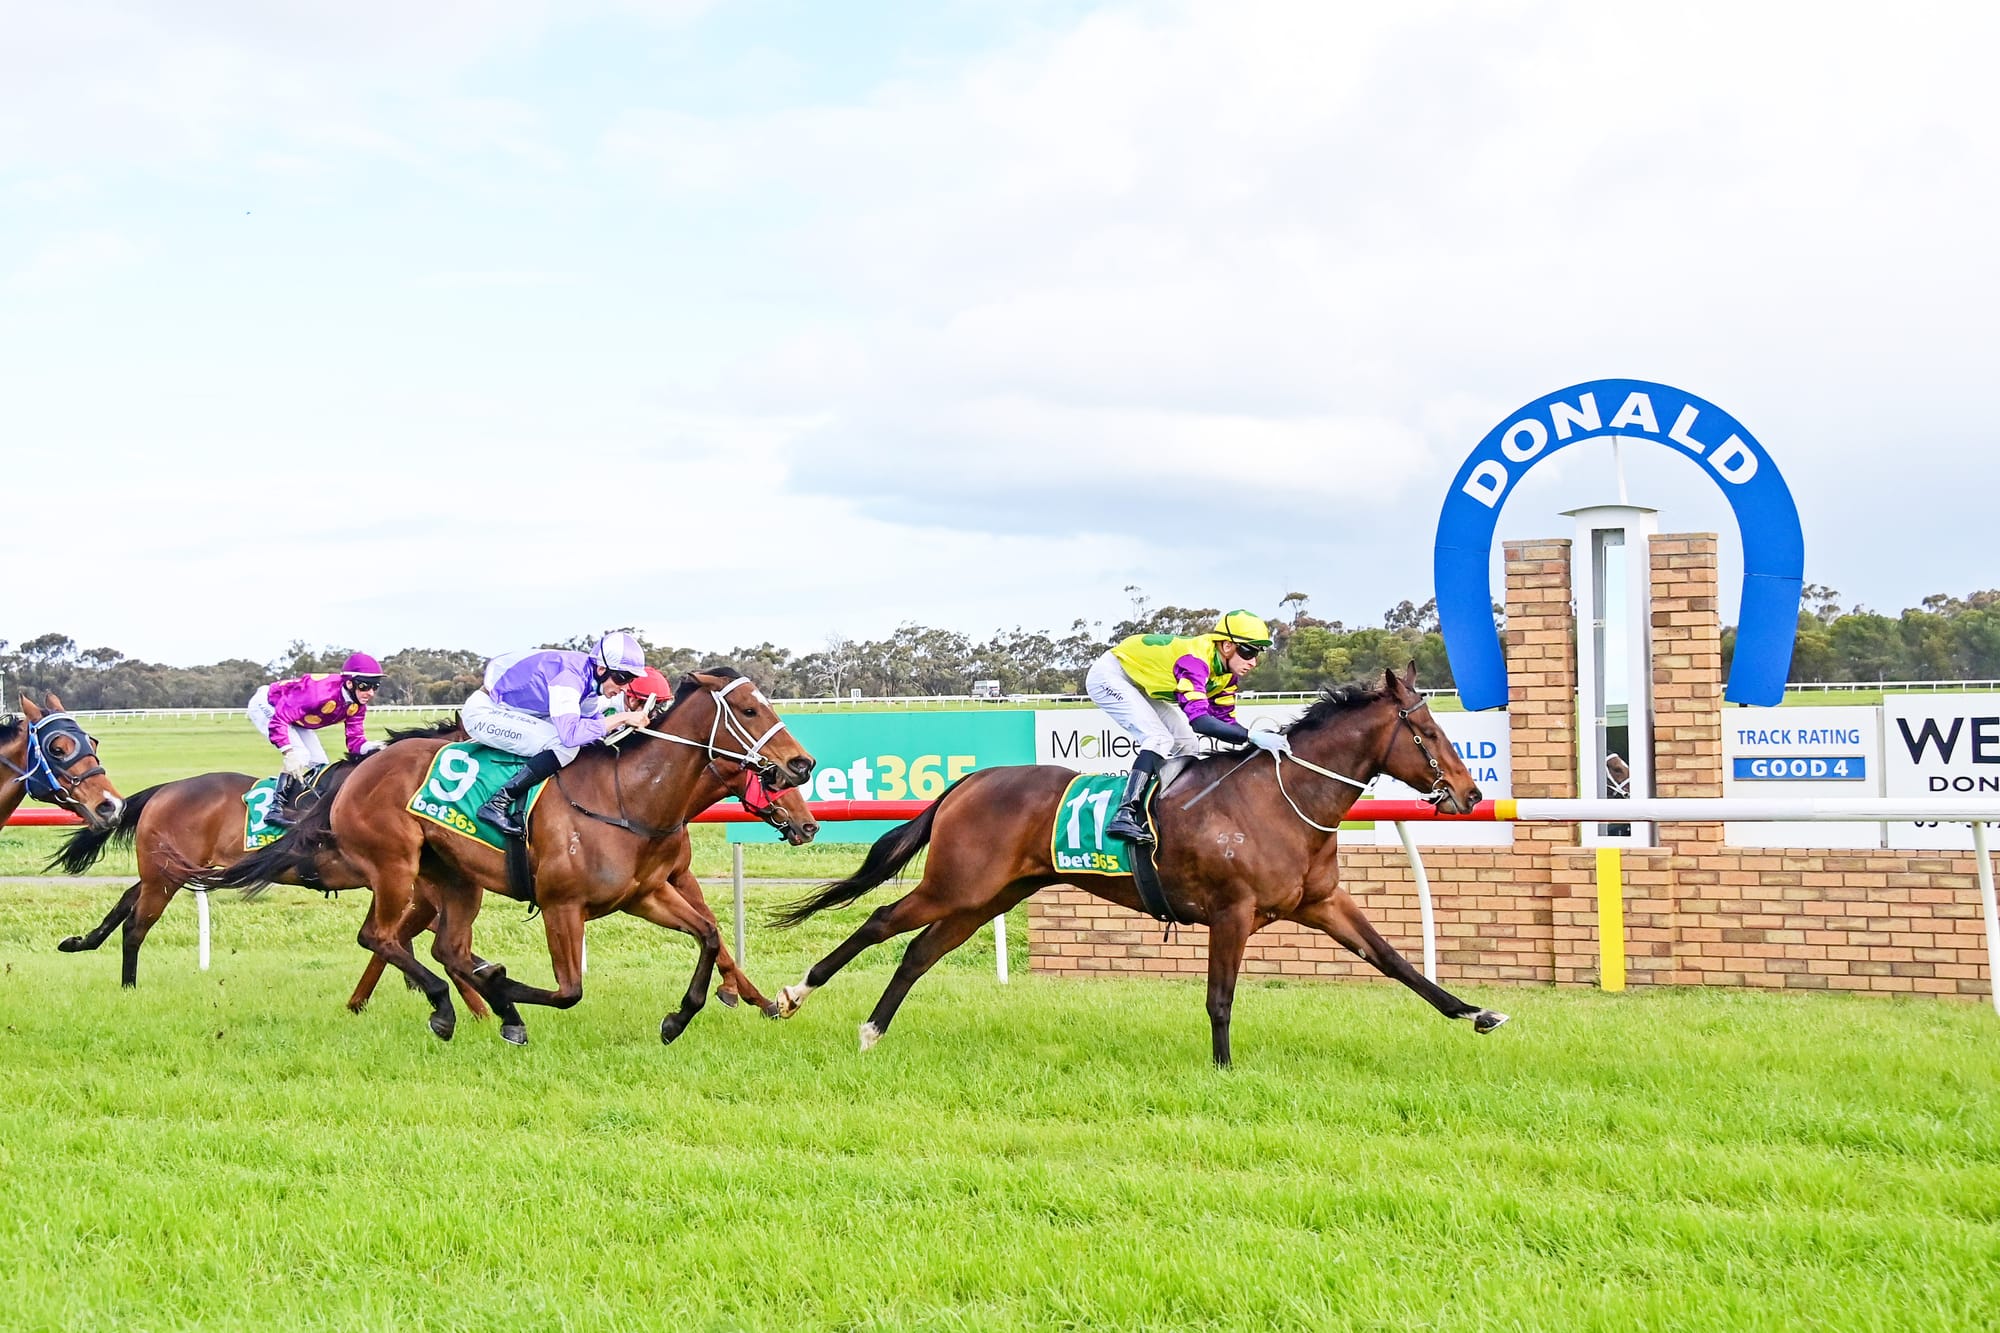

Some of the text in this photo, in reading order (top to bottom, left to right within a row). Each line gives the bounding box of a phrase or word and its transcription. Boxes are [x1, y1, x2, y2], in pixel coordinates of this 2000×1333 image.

[1462, 391, 1759, 509] DONALD
[1737, 729, 1860, 745] TRACK RATING
[1452, 741, 1497, 759] ALD
[429, 748, 480, 802] 9
[1751, 760, 1849, 777] GOOD 4
[1929, 776, 1999, 792] DON
[245, 786, 275, 832] 3
[412, 793, 477, 834] bet365
[1066, 787, 1114, 851] 11
[247, 833, 284, 848] et36
[1057, 851, 1119, 870] bet365
